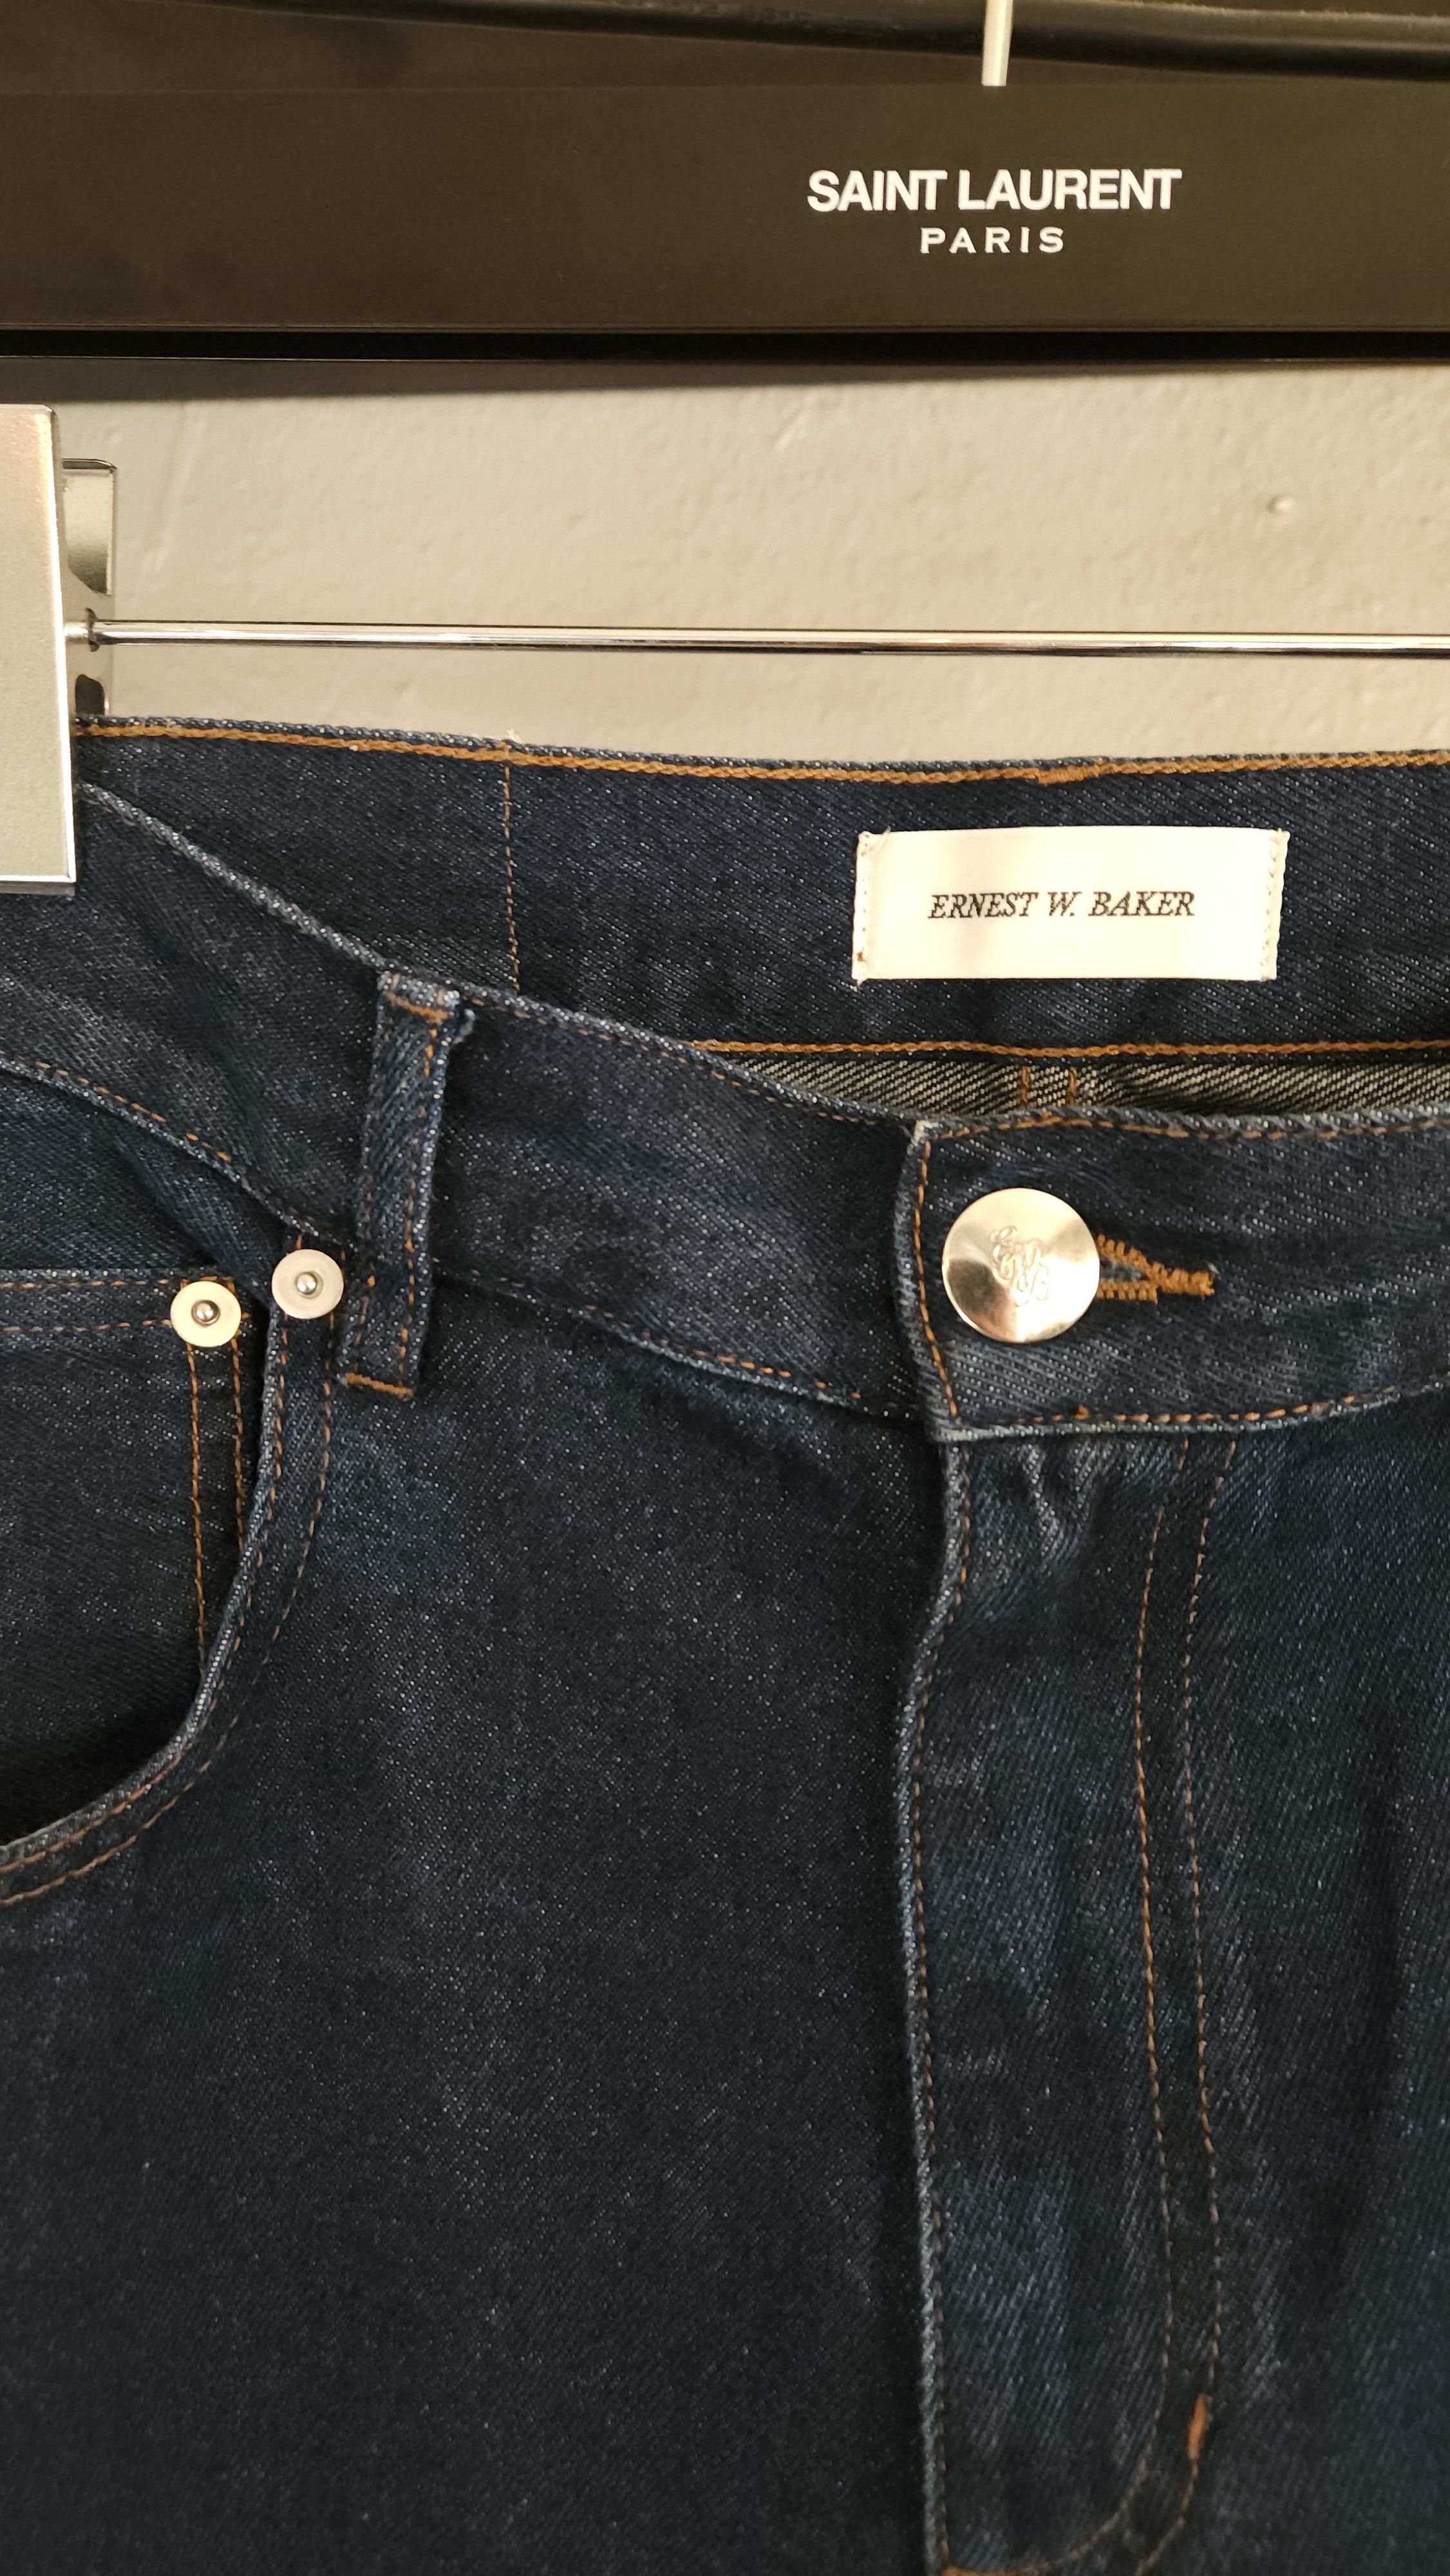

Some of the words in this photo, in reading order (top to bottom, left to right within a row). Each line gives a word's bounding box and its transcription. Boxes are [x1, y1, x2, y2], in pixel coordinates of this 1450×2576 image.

[807, 169, 948, 212] SAINT
[957, 168, 1183, 211] LAURENT
[919, 226, 1064, 254] PARIS
[927, 892, 1039, 919] ERNEST
[1048, 891, 1081, 917] W.
[1088, 891, 1195, 917] BAKER
